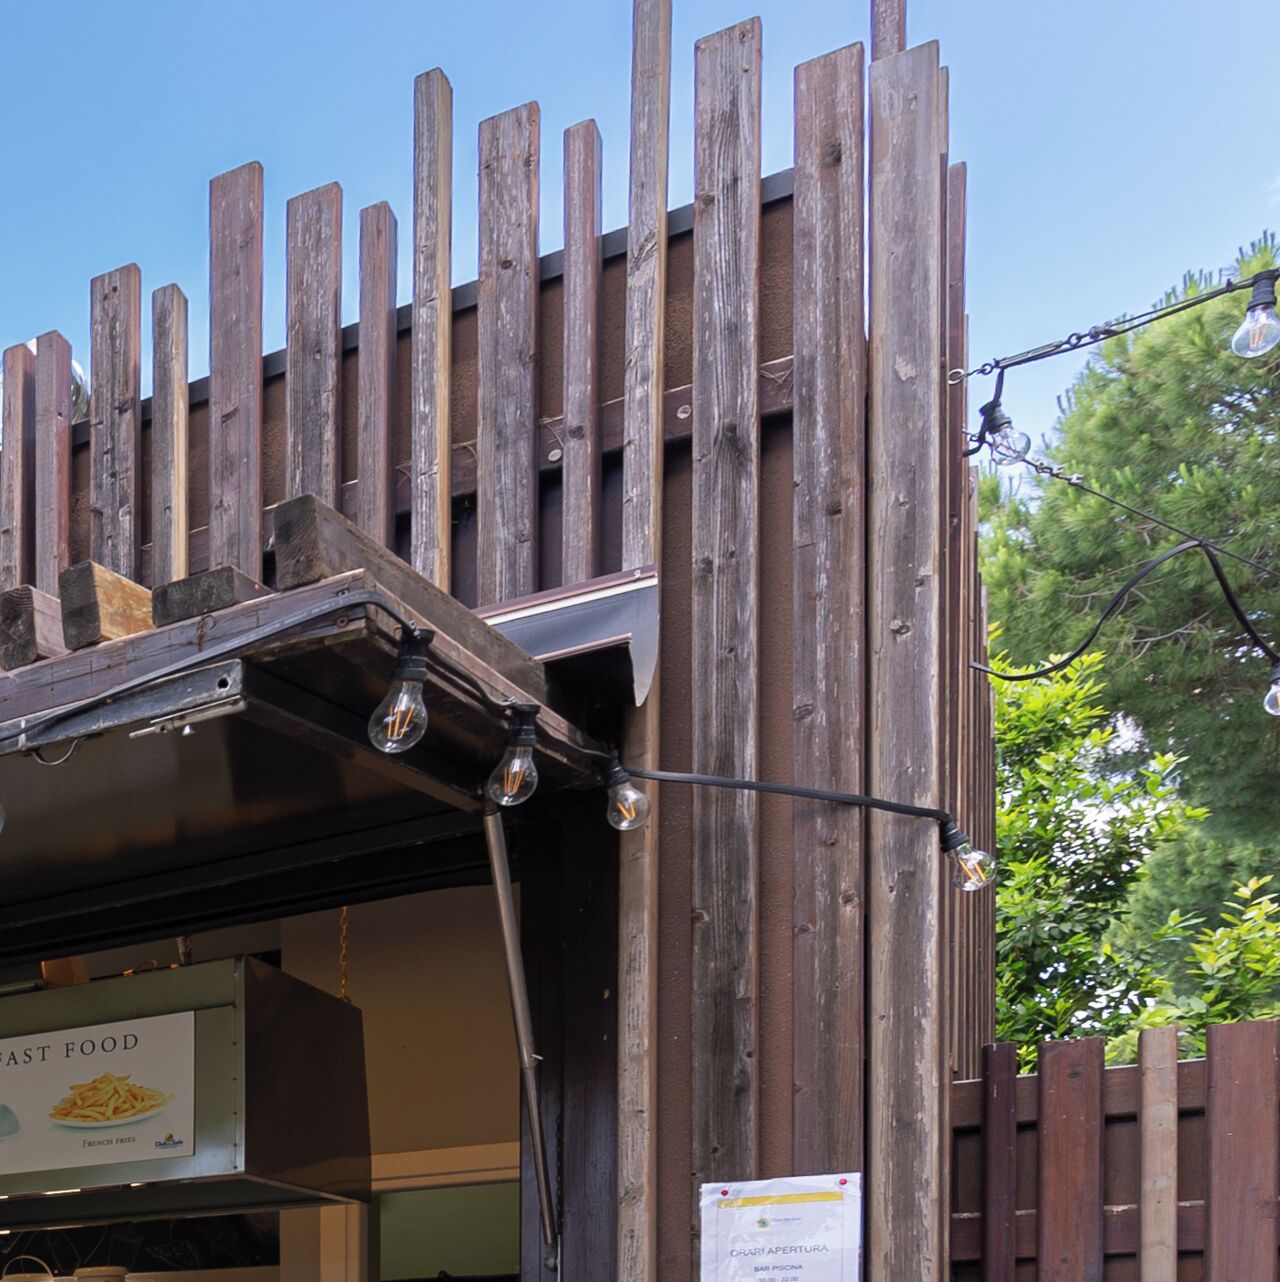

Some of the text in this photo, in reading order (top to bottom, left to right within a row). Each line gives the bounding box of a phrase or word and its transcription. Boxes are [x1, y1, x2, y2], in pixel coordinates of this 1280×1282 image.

[65, 1033, 138, 1058] FOOD
[730, 1244, 828, 1257] ORARI APERTURA
